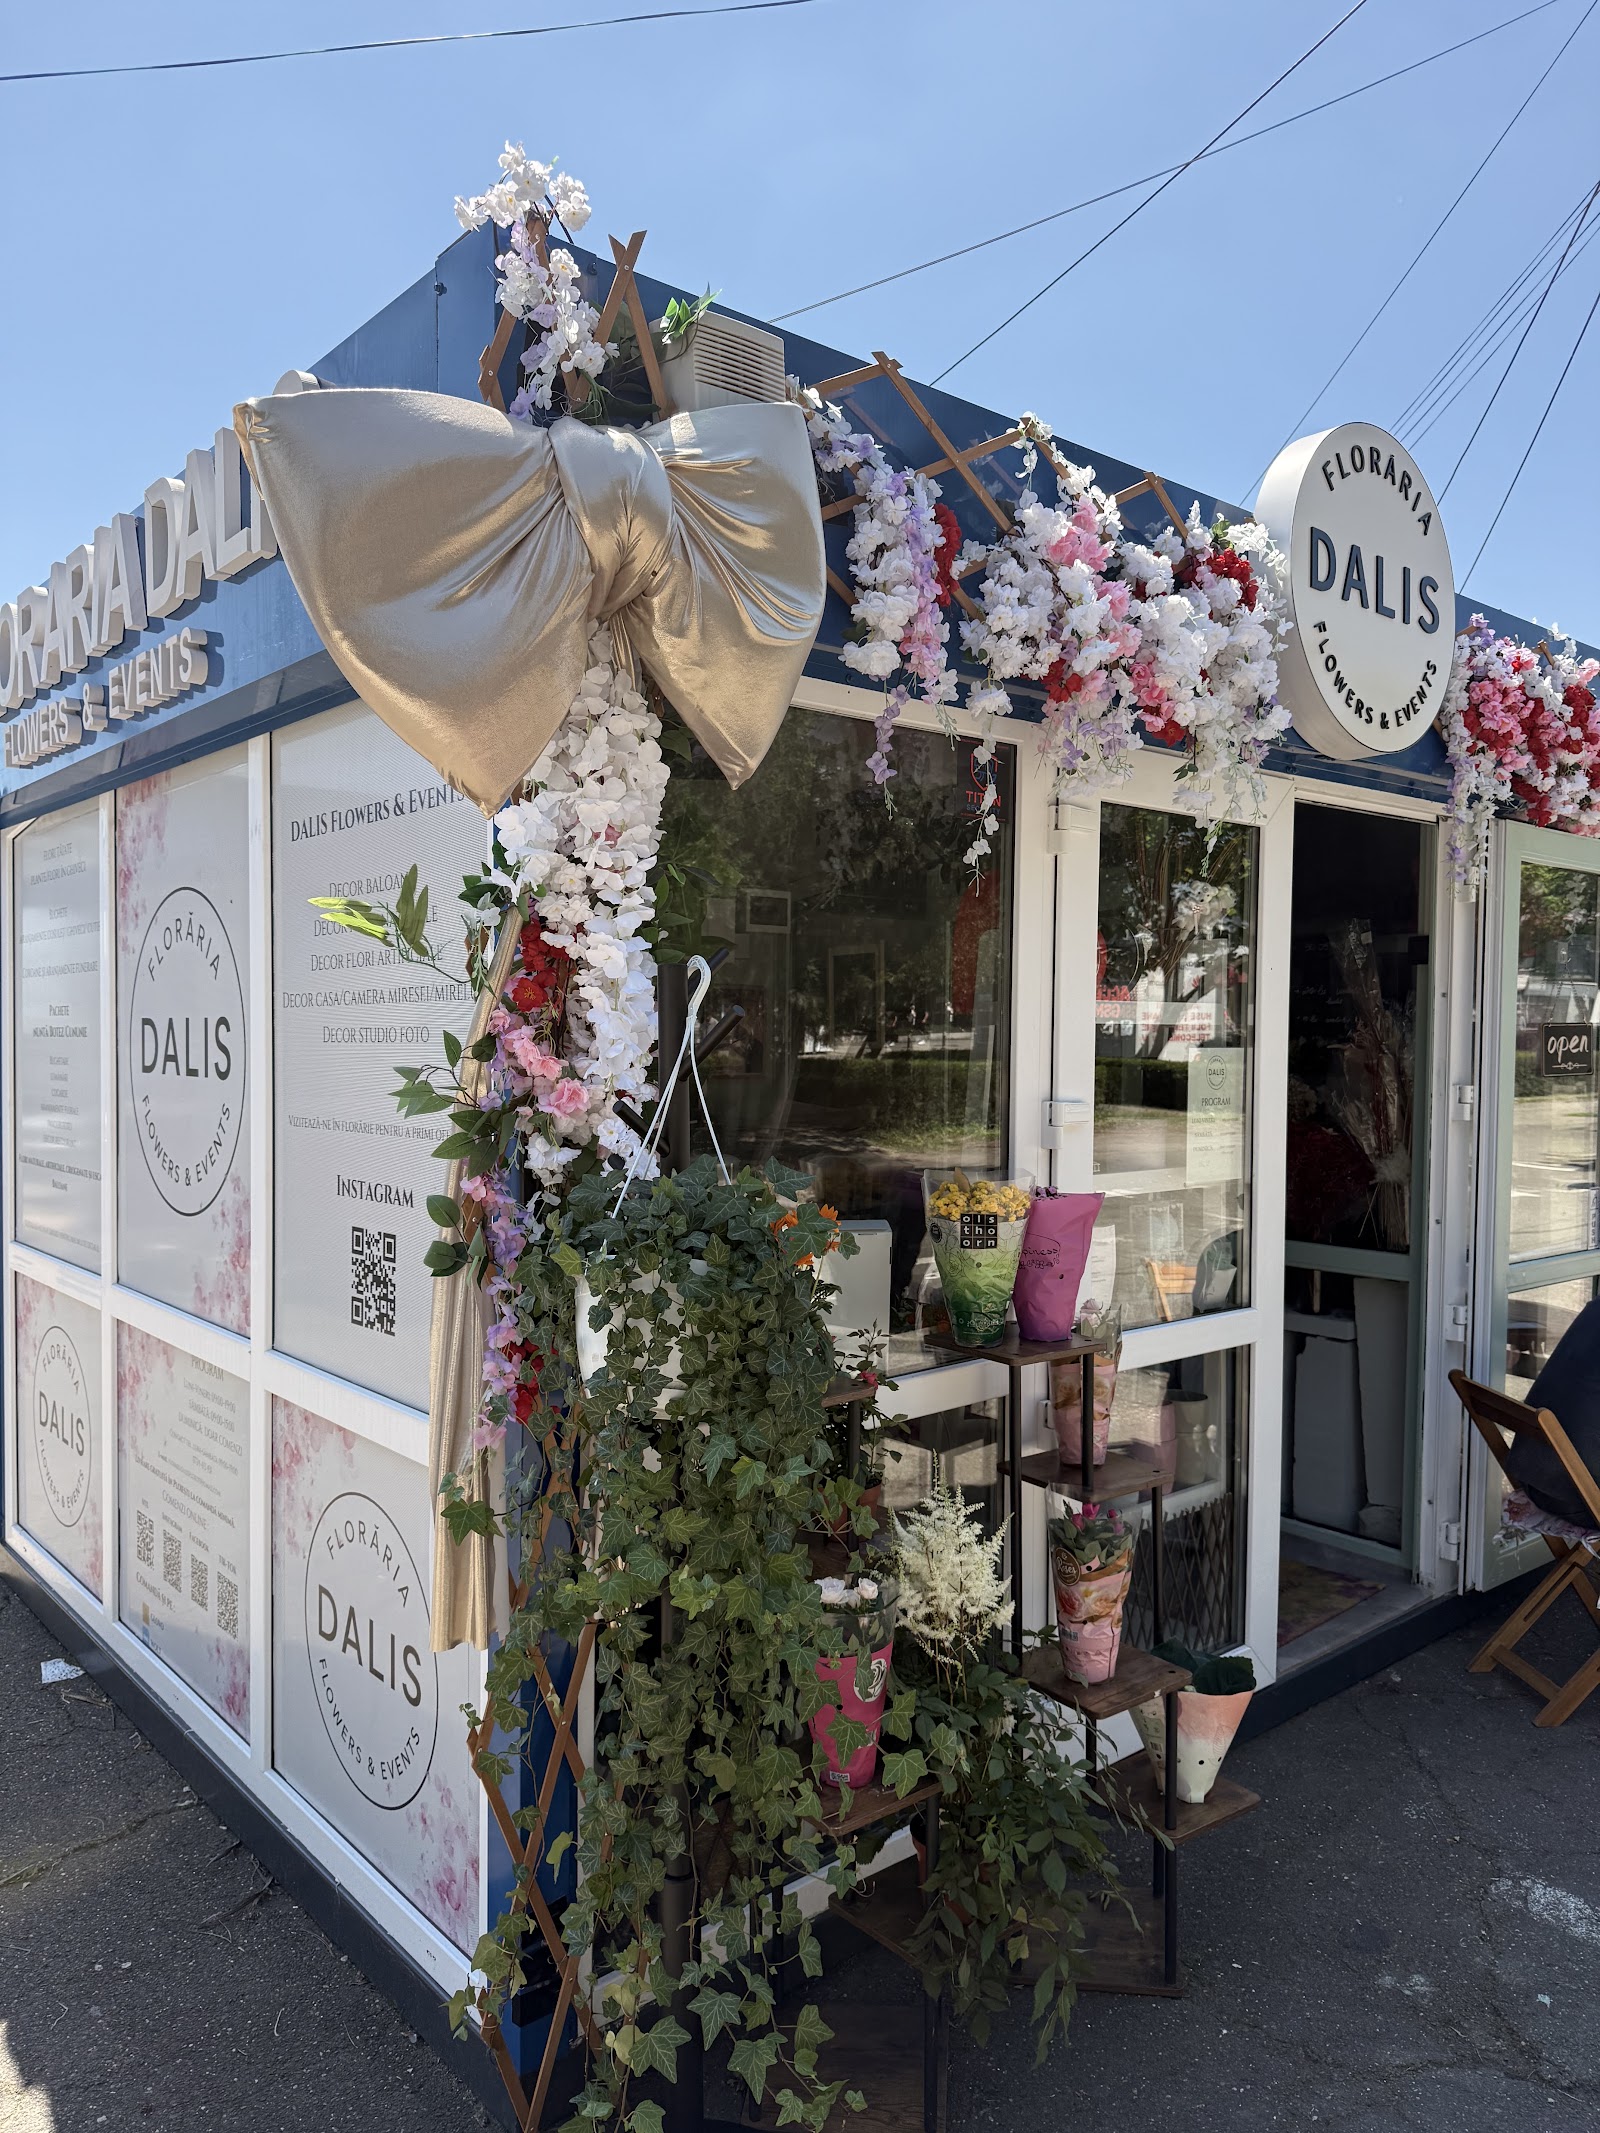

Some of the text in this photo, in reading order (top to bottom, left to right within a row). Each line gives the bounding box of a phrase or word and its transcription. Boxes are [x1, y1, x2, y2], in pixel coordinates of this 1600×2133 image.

[1321, 444, 1433, 537] FLORĂRIA
[1310, 526, 1440, 635] DALIS
[0, 512, 147, 716] ORARIA
[1313, 620, 1438, 730] FLOWERS & EVENTS
[5, 626, 209, 768] FLOWERS & EVENTS
[291, 812, 328, 842] DALIS
[331, 799, 390, 833] FLOWERS
[393, 793, 406, 817] &
[965, 790, 1002, 808] TITN
[329, 880, 364, 898] DECOR
[147, 911, 221, 981] FLORĂRIA
[311, 953, 345, 971] DECOR
[346, 951, 375, 969] FLORI
[283, 992, 314, 1009] DECOR
[315, 989, 384, 1008] CASA/CAMERA
[141, 1016, 231, 1081] DALIS
[323, 1025, 430, 1043] DECOR STUDIO FOTO
[1546, 1034, 1589, 1063] open
[1208, 1068, 1225, 1076] DALIS
[1201, 1097, 1231, 1107] PROGRAM
[142, 1095, 231, 1187] FLOWERS & EVENTS
[341, 1119, 375, 1135] FLORĂRIE
[375, 1123, 404, 1138] PENTRU
[404, 1126, 411, 1139] A
[412, 1127, 434, 1141] PRIMI
[336, 1174, 414, 1208] INSTAGRAM
[962, 1214, 995, 1224] ols
[963, 1225, 996, 1235] tho
[962, 1238, 995, 1247] orn
[39, 1391, 85, 1457] DALIS
[326, 1520, 410, 1608] FLORĂRIA
[318, 1584, 422, 1707] DALIS
[319, 1658, 421, 1781] FLOWERS & EVENTS
